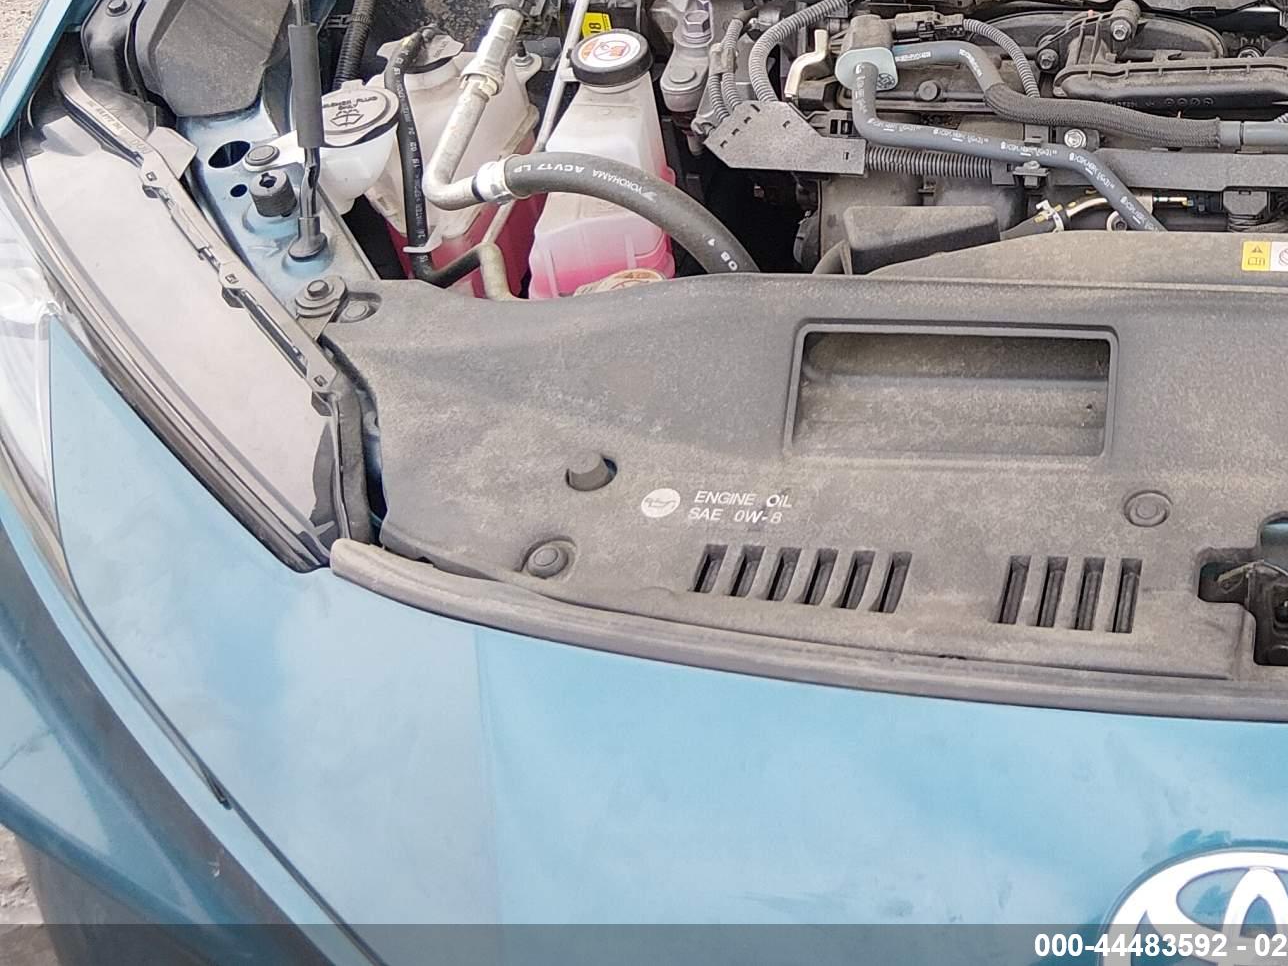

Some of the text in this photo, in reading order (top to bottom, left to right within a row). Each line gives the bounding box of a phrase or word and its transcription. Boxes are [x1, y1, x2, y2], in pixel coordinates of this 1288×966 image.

[537, 163, 585, 174] ACV17
[592, 169, 644, 195] YOKOHAMA
[694, 490, 758, 506] ENGINE
[687, 507, 724, 521] SAE
